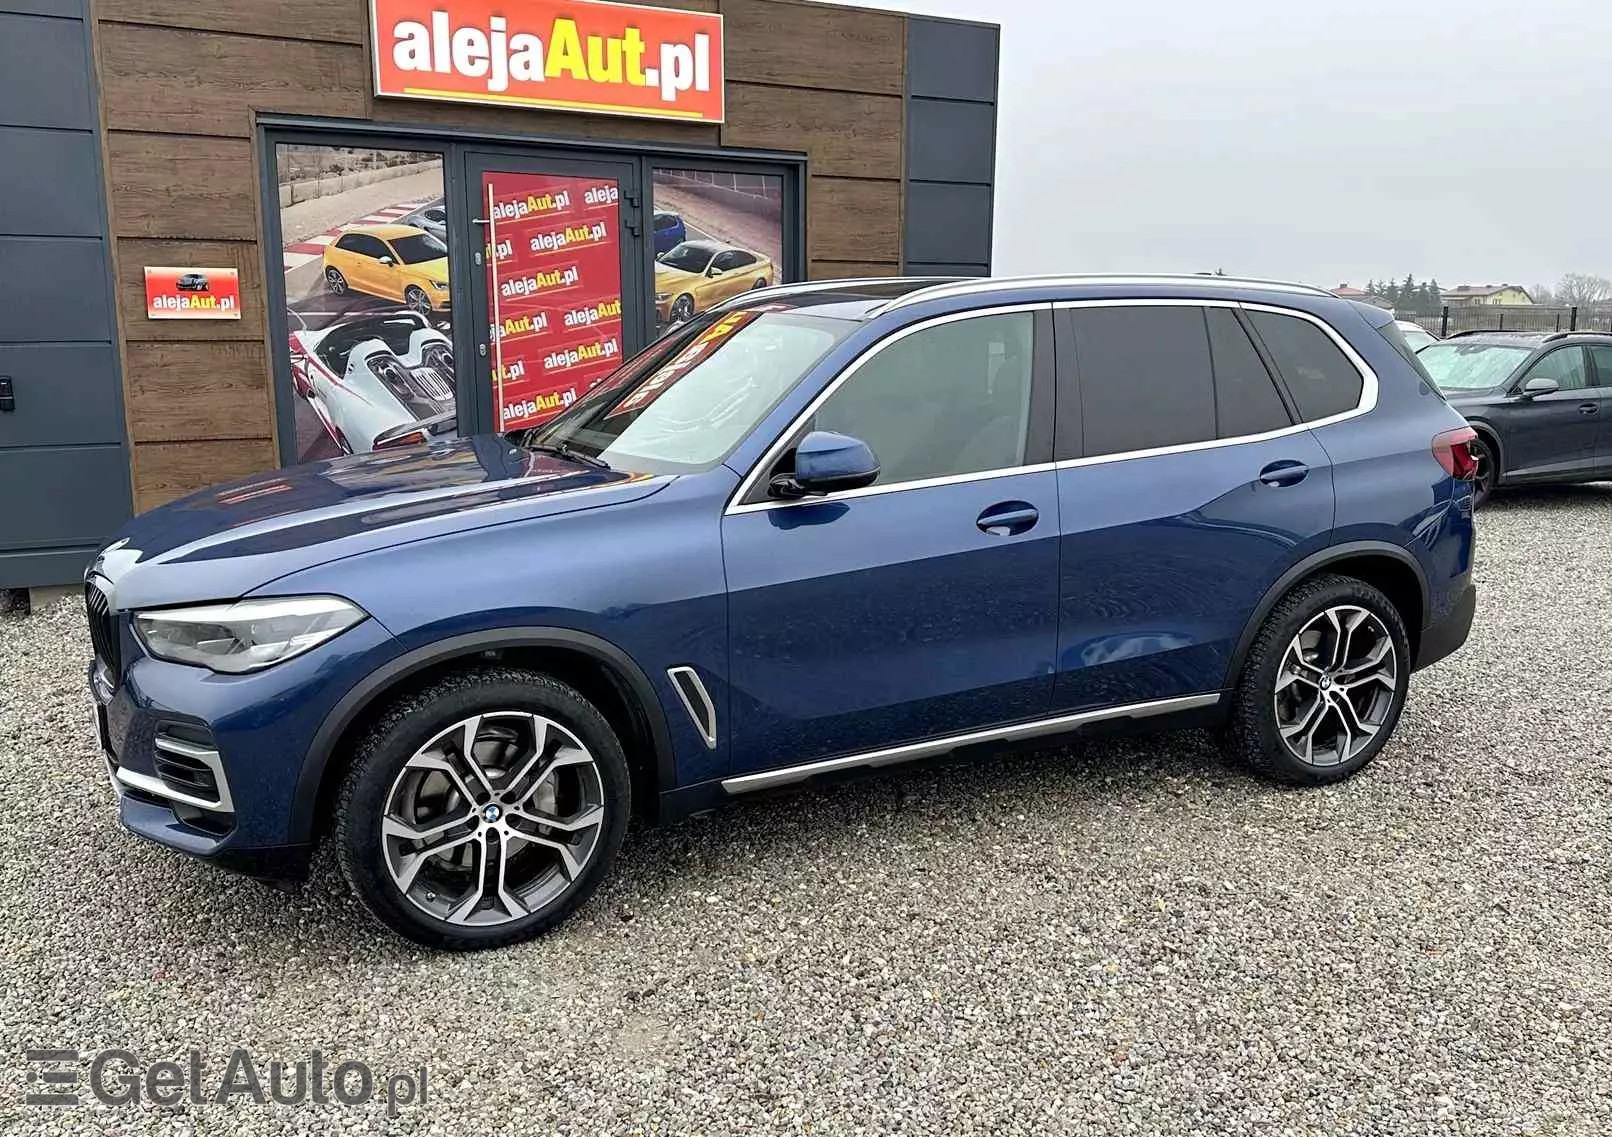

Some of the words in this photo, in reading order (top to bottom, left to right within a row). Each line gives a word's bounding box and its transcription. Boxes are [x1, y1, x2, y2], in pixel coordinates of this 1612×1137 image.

[392, 10, 711, 101] alejaAut.pl
[493, 190, 570, 219] alejaAut.pl
[584, 185, 618, 204] aleja
[530, 221, 607, 251] alejaAut.pl
[501, 265, 579, 296] alejaAut.pl
[152, 294, 235, 312] alejaAut.pl
[564, 299, 621, 326] alejaAut
[543, 338, 619, 369] alejaAut.pl
[503, 387, 577, 419] alejaAut.pl
